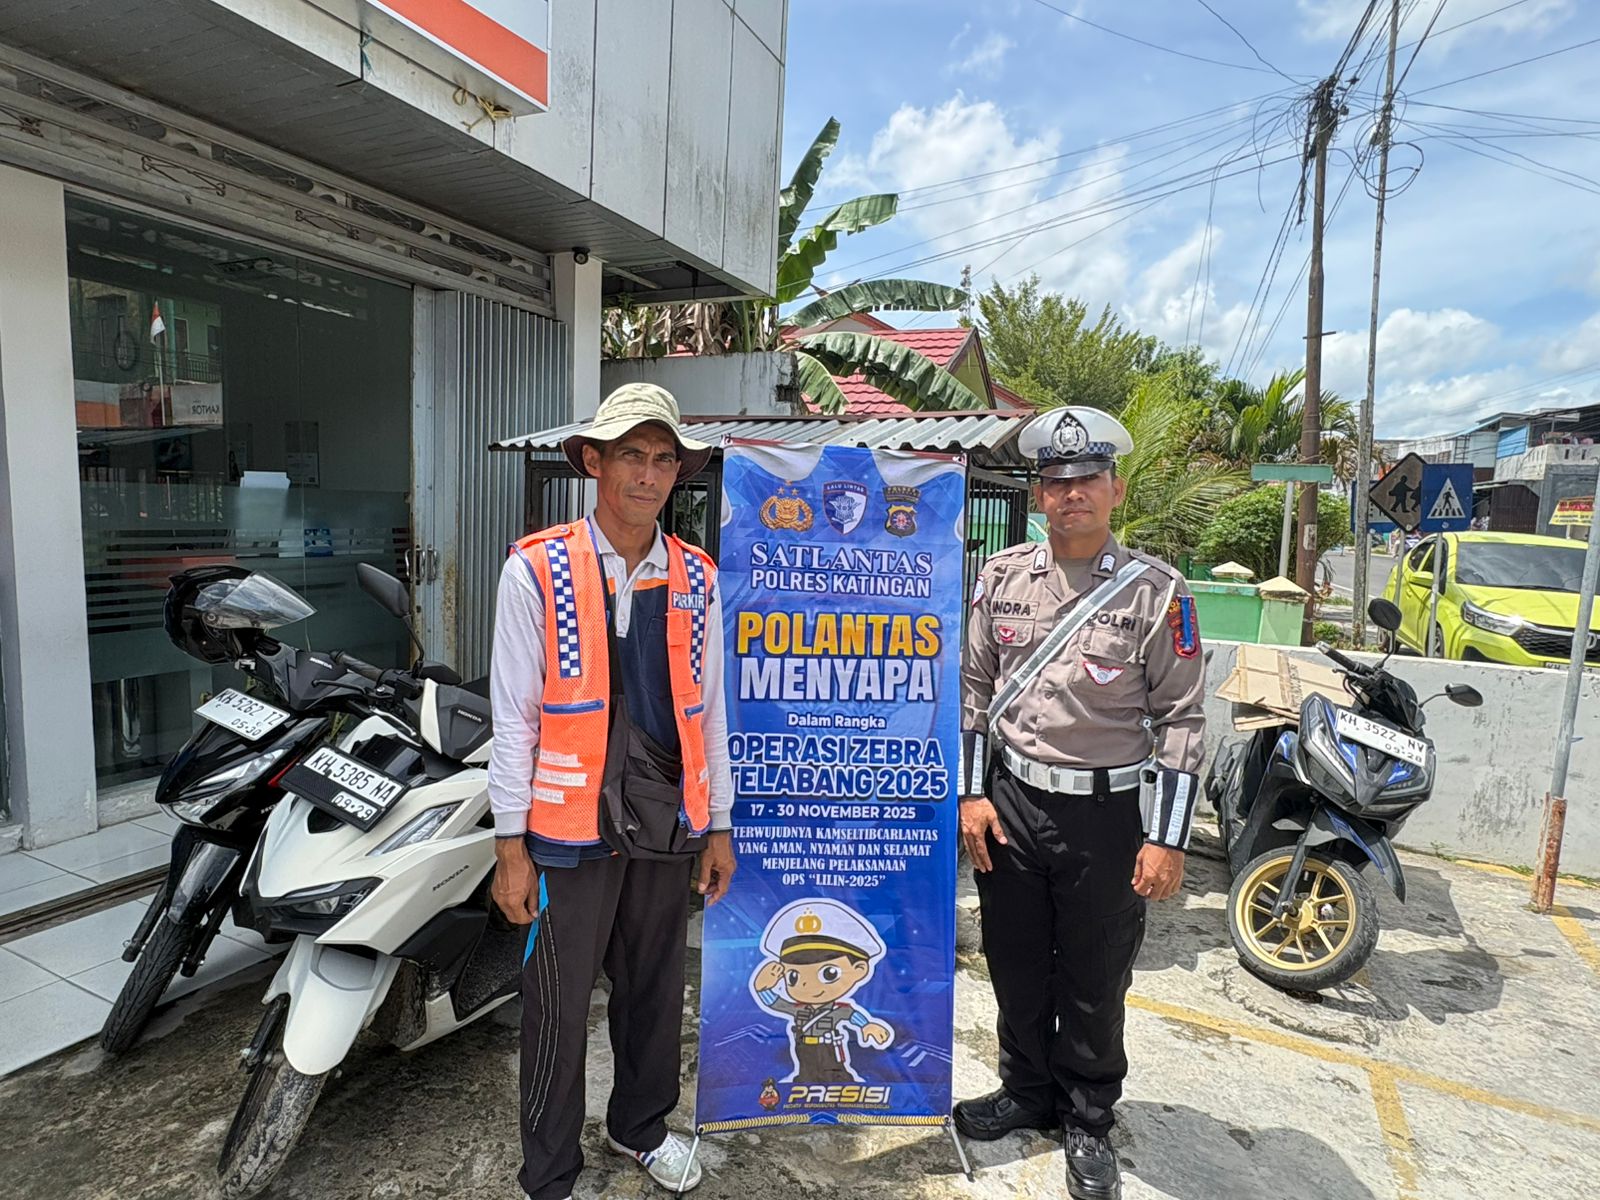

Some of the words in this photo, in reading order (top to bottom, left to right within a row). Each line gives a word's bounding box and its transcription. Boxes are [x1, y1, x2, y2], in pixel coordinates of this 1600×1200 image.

[844, 485, 864, 493] LINTAS
[751, 543, 932, 576] SATLANTAS
[752, 570, 827, 593] POLRES
[833, 575, 930, 598] KATINGAN
[673, 592, 705, 609] PARKIR
[992, 600, 1031, 616] INDRA
[736, 611, 941, 658] POLANTAS
[739, 657, 935, 701] MENYAPA
[216, 689, 238, 704] KH
[232, 697, 264, 716] 5262
[263, 711, 284, 726] TZ
[788, 713, 831, 727] Dalam
[835, 714, 886, 730] Rangka
[1340, 712, 1357, 726] KH
[1364, 721, 1397, 742] 3522
[1407, 738, 1425, 753] NV
[728, 732, 847, 765] OPERASI
[850, 737, 944, 767] ZEBRA
[311, 752, 338, 773] KH
[333, 762, 375, 790] 5385
[369, 780, 396, 802] NA
[877, 768, 948, 799] 2025
[750, 804, 765, 816] 17
[777, 804, 794, 816] 30
[799, 804, 879, 818] NOVEMBER
[883, 806, 916, 819] 2025
[733, 826, 812, 839] TERWUJUDNYA
[816, 827, 938, 841] KAMSELTIBCARLANTAS
[738, 842, 767, 854] YANG
[771, 842, 806, 855] AMAN,
[810, 842, 854, 855] NYAMAN
[858, 844, 880, 856] DAN
[884, 844, 931, 856] SELAMAT
[763, 858, 824, 870] MENJELANG
[829, 859, 906, 871] PELAKSANAAN
[432, 865, 469, 891] HONDA
[782, 873, 805, 886] OPS
[788, 1085, 891, 1103] PRESISI
